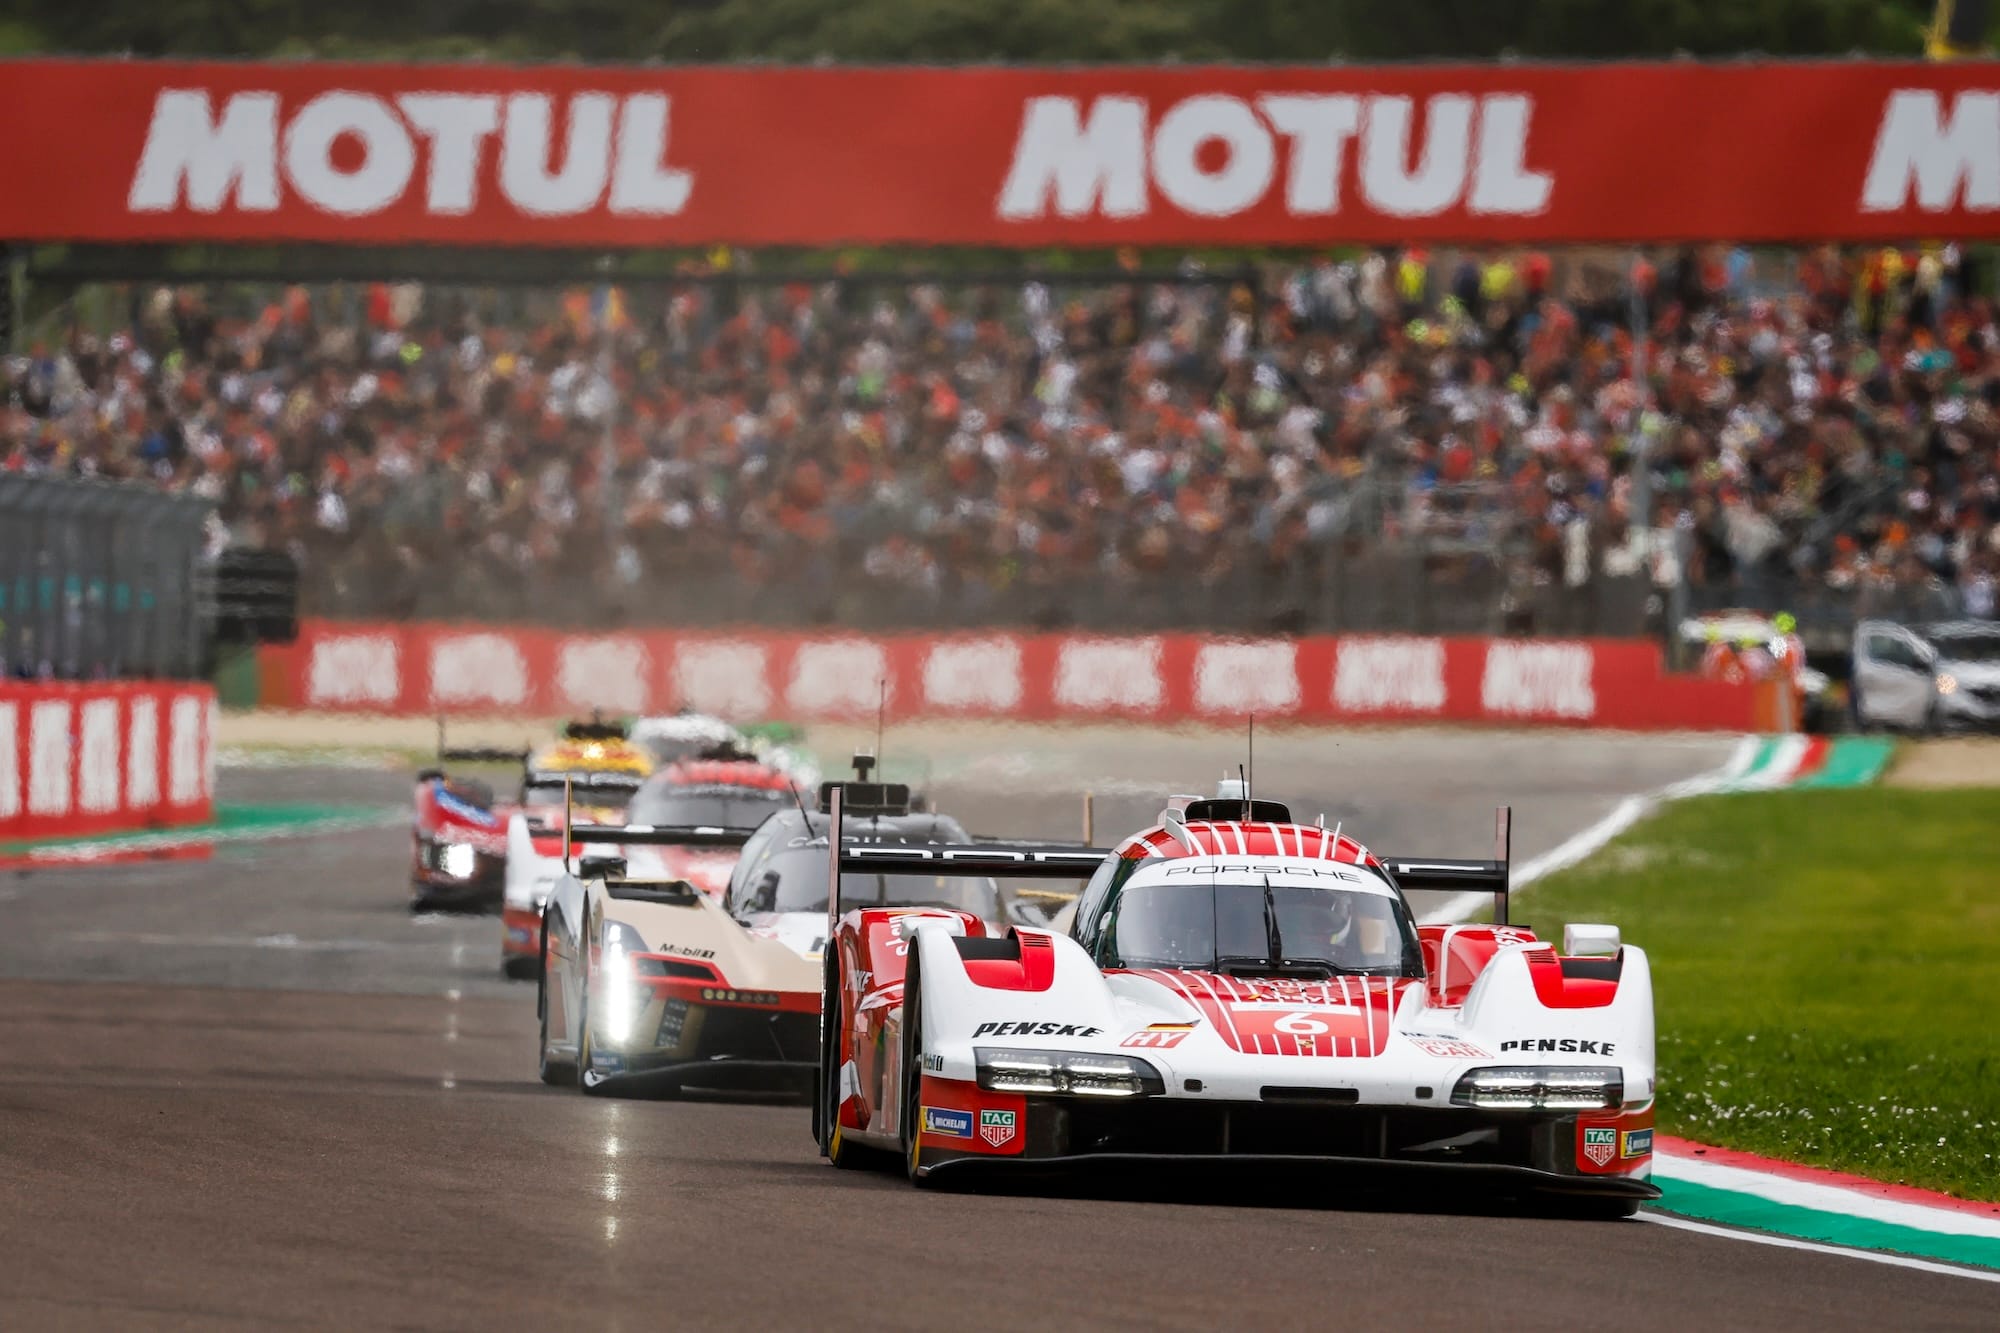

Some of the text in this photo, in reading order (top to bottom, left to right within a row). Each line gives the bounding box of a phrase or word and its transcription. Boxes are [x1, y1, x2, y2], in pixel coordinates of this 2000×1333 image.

[127, 88, 693, 218] MOTUL
[996, 91, 1554, 217] MOTUL
[1166, 865, 1363, 884] PORSCHE
[660, 943, 701, 956] Mobil
[971, 1020, 1105, 1039] PENSKE
[1273, 1012, 1329, 1036] 6
[1124, 1031, 1184, 1047] HY
[1500, 1039, 1616, 1057] PENSKE
[1426, 1045, 1487, 1057] CAR
[935, 1116, 968, 1130] MICHELIN
[983, 1112, 1013, 1125] TAG
[982, 1126, 1013, 1144] HEUER
[1587, 1131, 1614, 1143] TAG
[1586, 1144, 1615, 1163] HEUER
